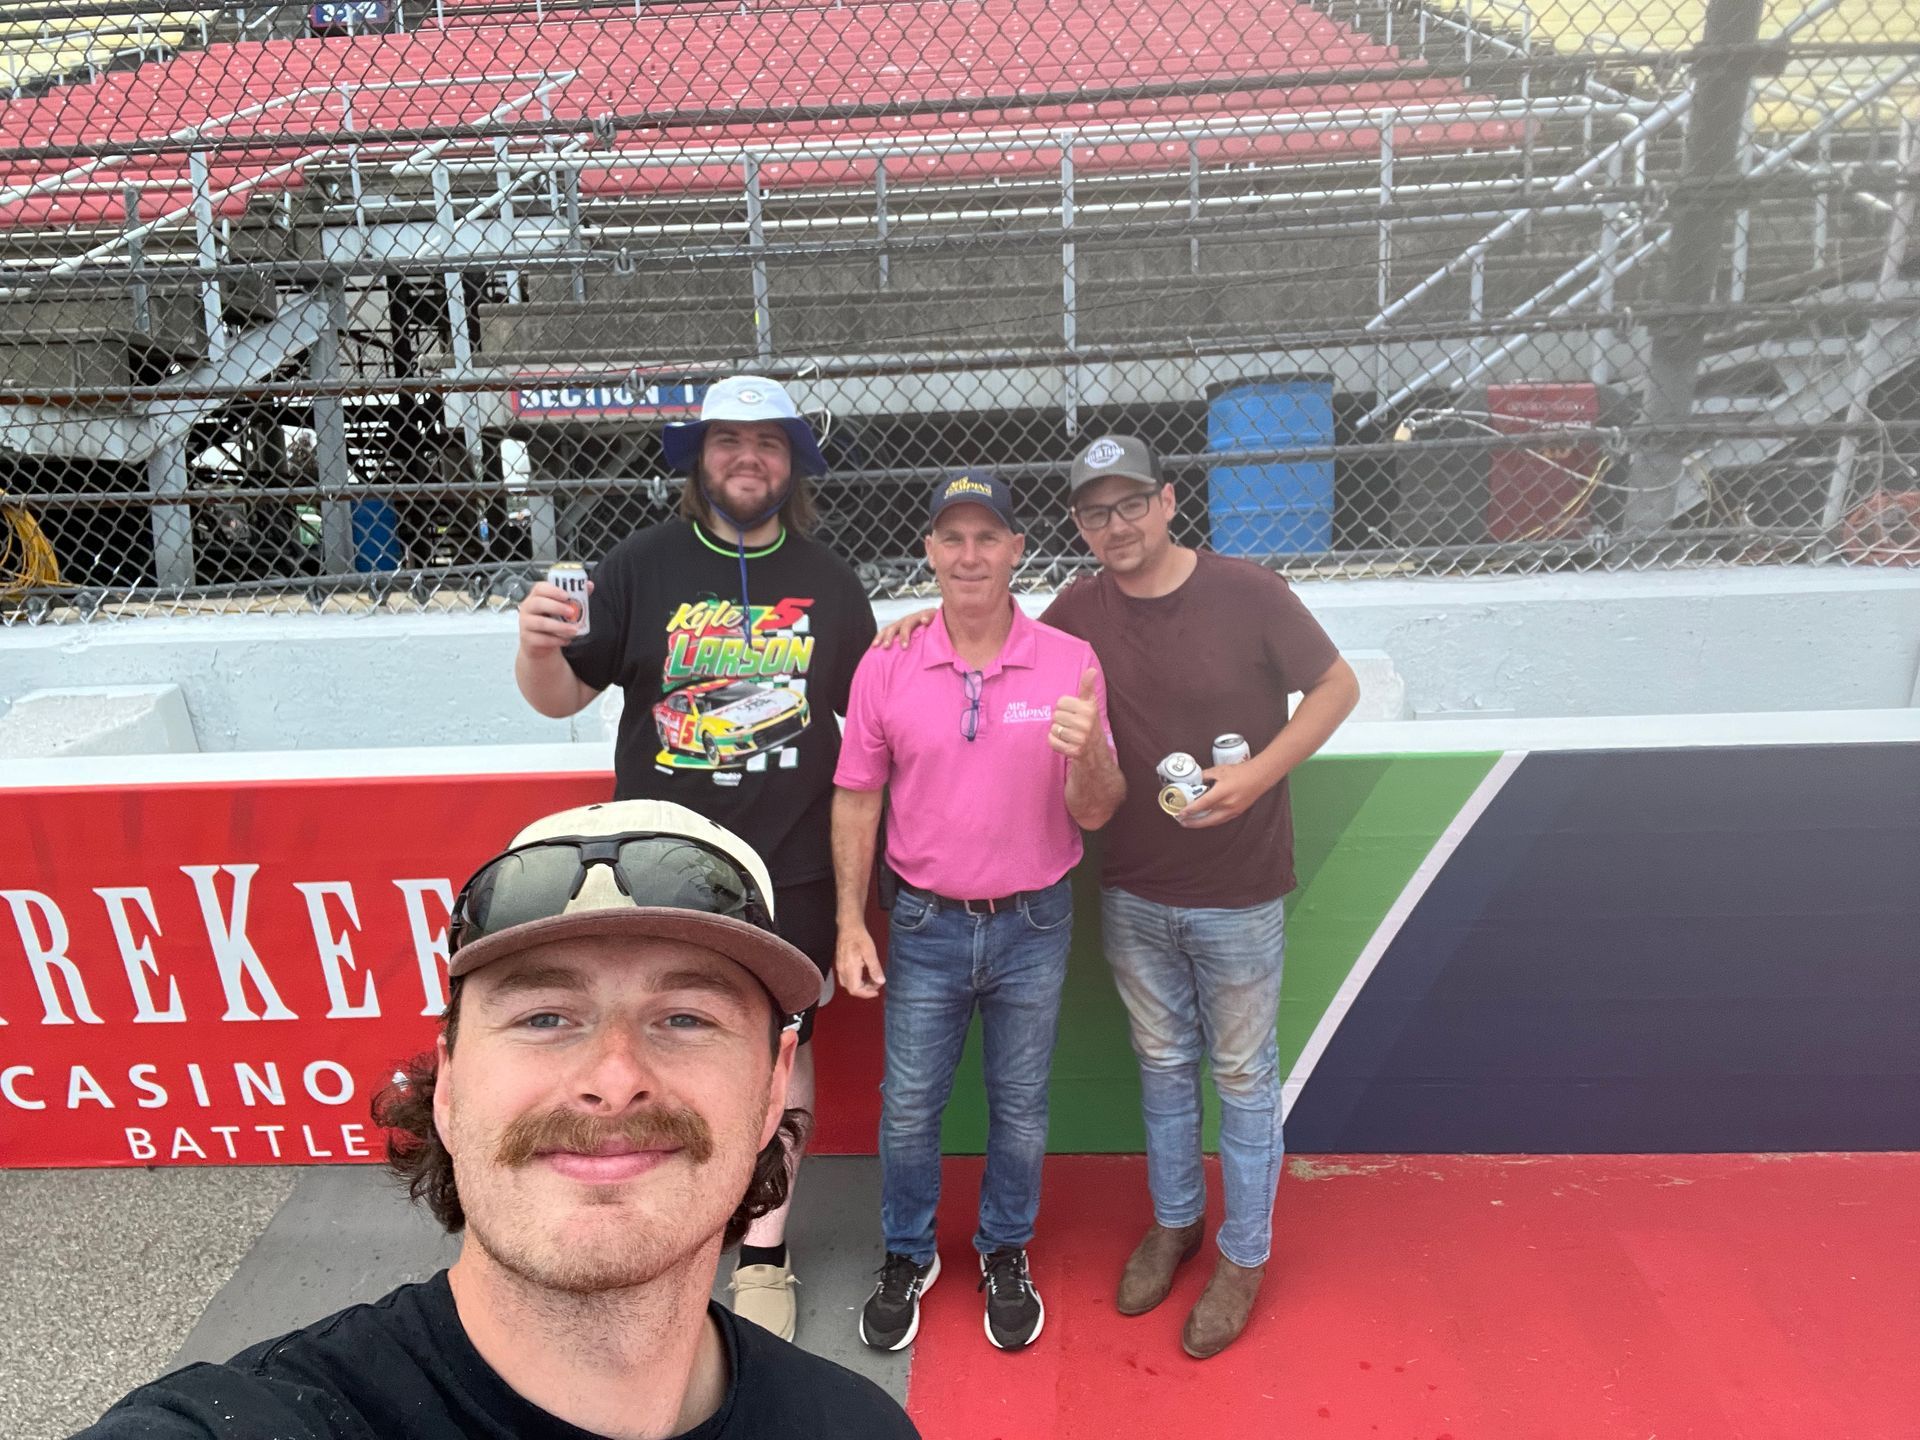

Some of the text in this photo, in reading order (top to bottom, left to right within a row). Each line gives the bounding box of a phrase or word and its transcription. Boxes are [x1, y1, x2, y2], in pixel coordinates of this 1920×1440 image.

[519, 379, 660, 409] SECTION
[666, 597, 816, 637] Kyle 5
[668, 633, 816, 678] LARSON
[682, 721, 696, 745] 5
[0, 864, 455, 1027] REKEE
[0, 1060, 356, 1110] CASINO
[125, 1124, 370, 1160] BATTLE
